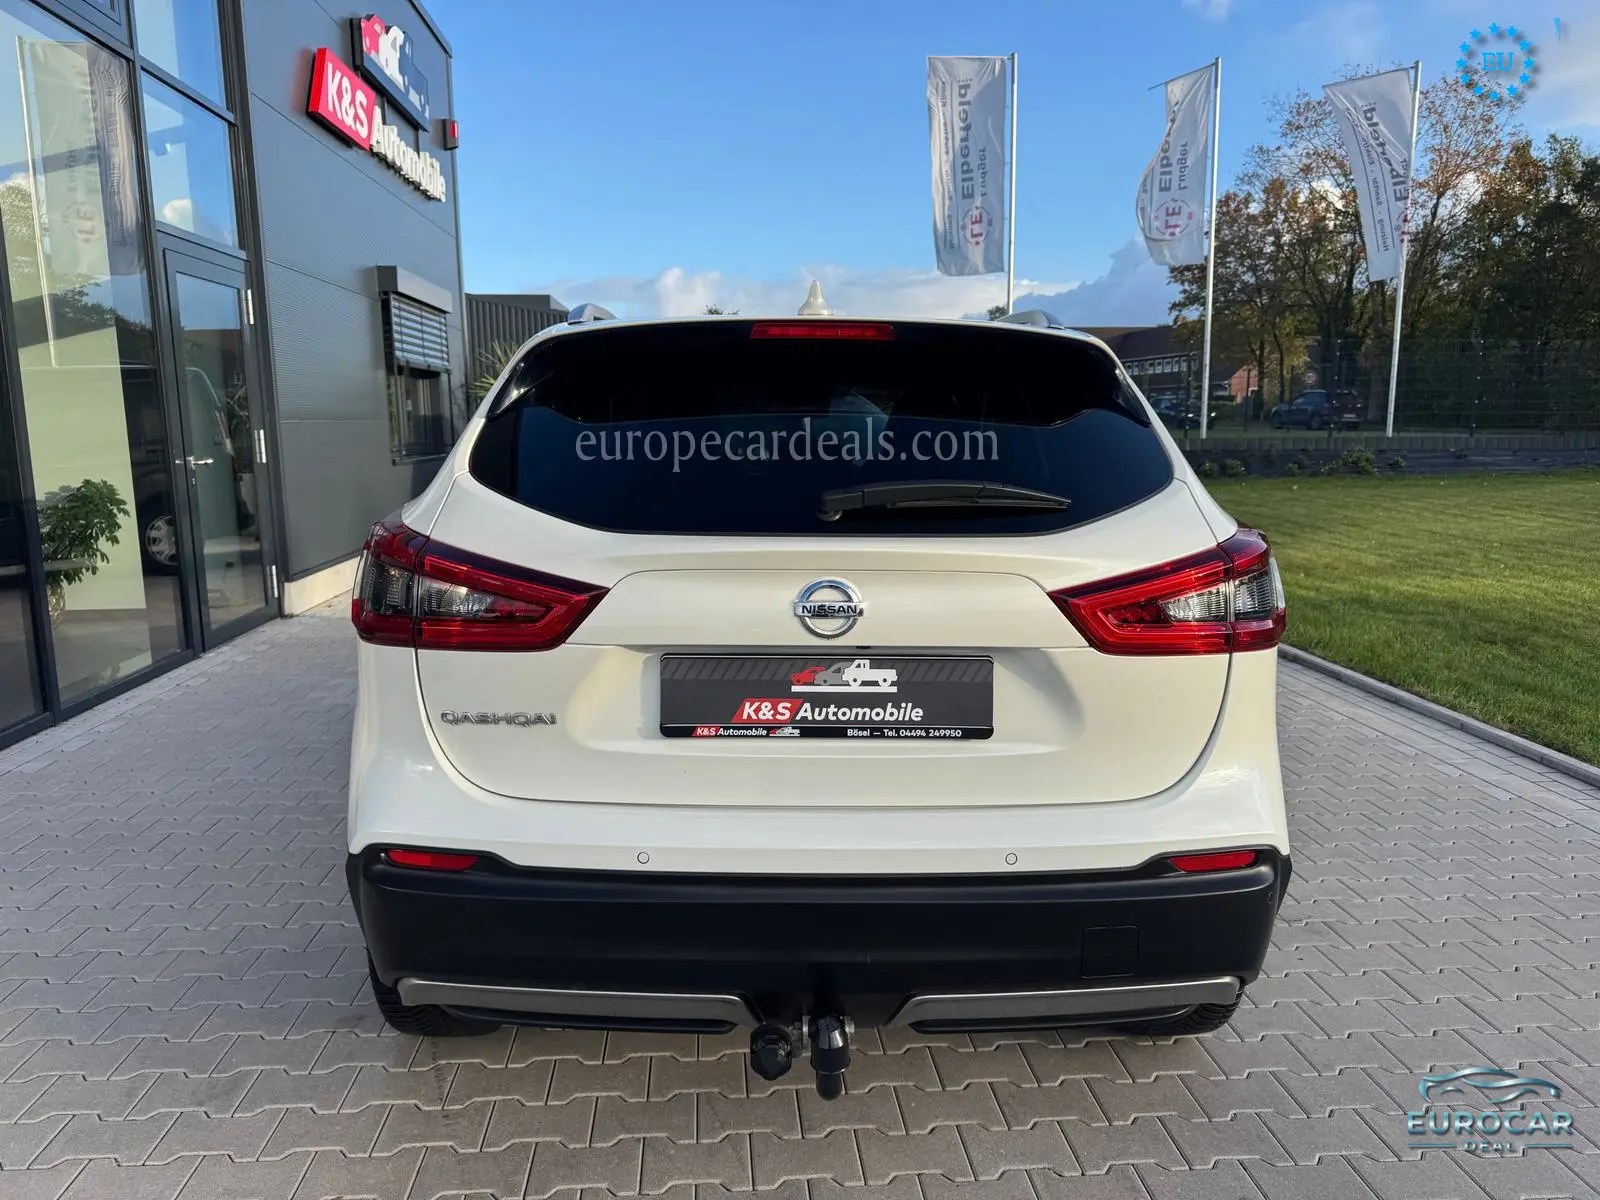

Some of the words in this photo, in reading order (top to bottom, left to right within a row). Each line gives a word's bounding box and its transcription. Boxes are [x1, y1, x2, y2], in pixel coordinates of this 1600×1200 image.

[327, 62, 368, 139] K&S
[370, 105, 446, 203] Automobile
[801, 604, 857, 614] NISSAN
[742, 702, 792, 720] K&S
[795, 702, 924, 721] Automobile
[440, 710, 557, 727] QASHQAI
[696, 728, 716, 736] K&S
[717, 728, 767, 736] Automobile
[847, 729, 870, 737] Bösel
[883, 729, 898, 737] Tel.
[899, 729, 926, 737] 04494
[928, 729, 962, 737] 249950
